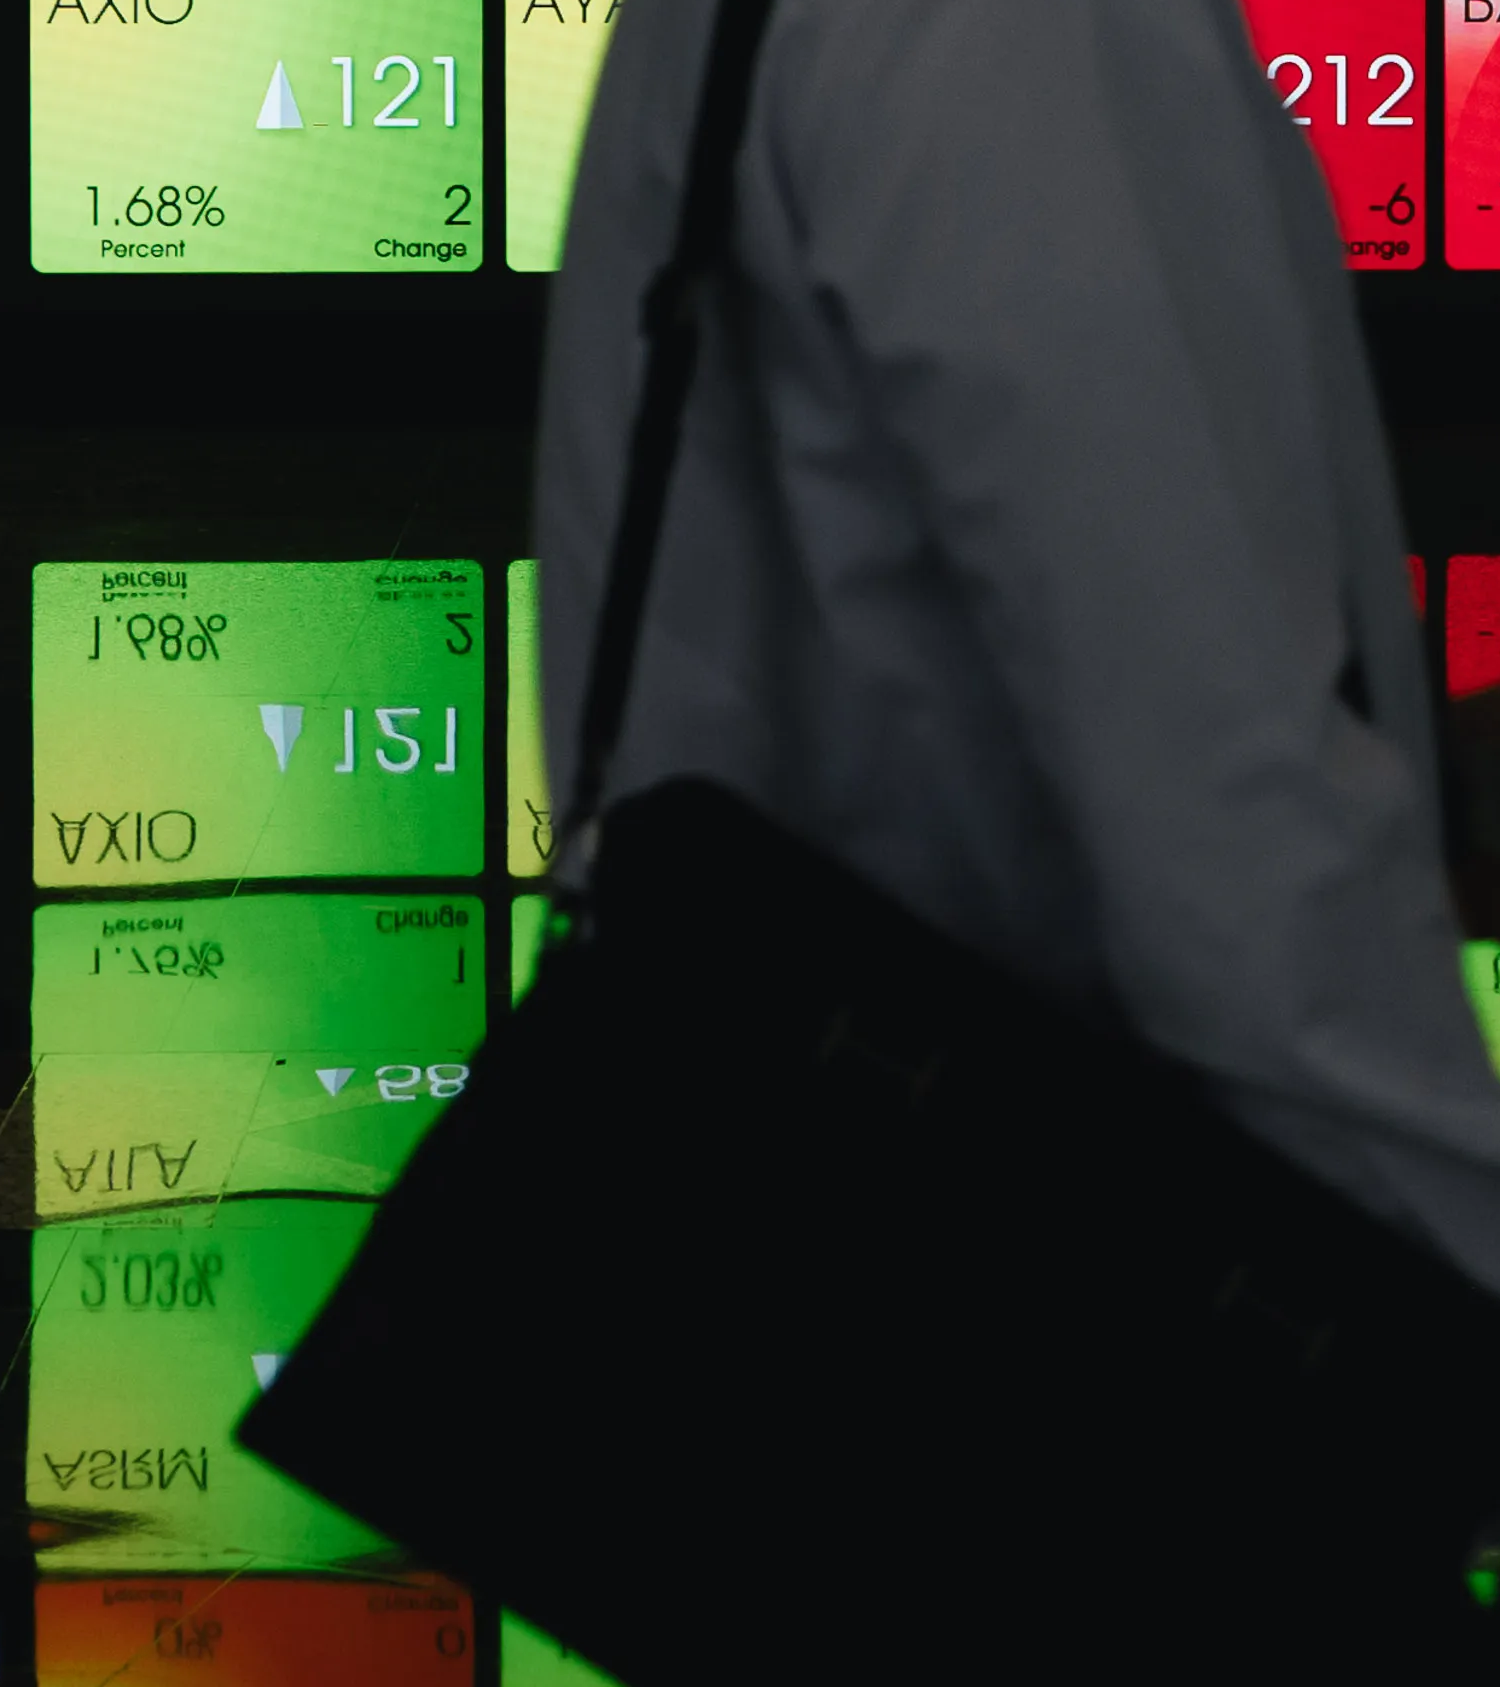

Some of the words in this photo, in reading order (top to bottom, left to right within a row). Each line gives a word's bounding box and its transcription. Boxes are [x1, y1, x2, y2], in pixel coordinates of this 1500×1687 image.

[332, 56, 458, 129] 121
[1266, 53, 1415, 128] 212
[87, 186, 225, 226] 1.68%
[445, 185, 471, 225] 2
[1369, 182, 1415, 225] -6
[102, 240, 185, 258] Percent
[375, 239, 467, 262] Change
[1342, 240, 1411, 261] ange
